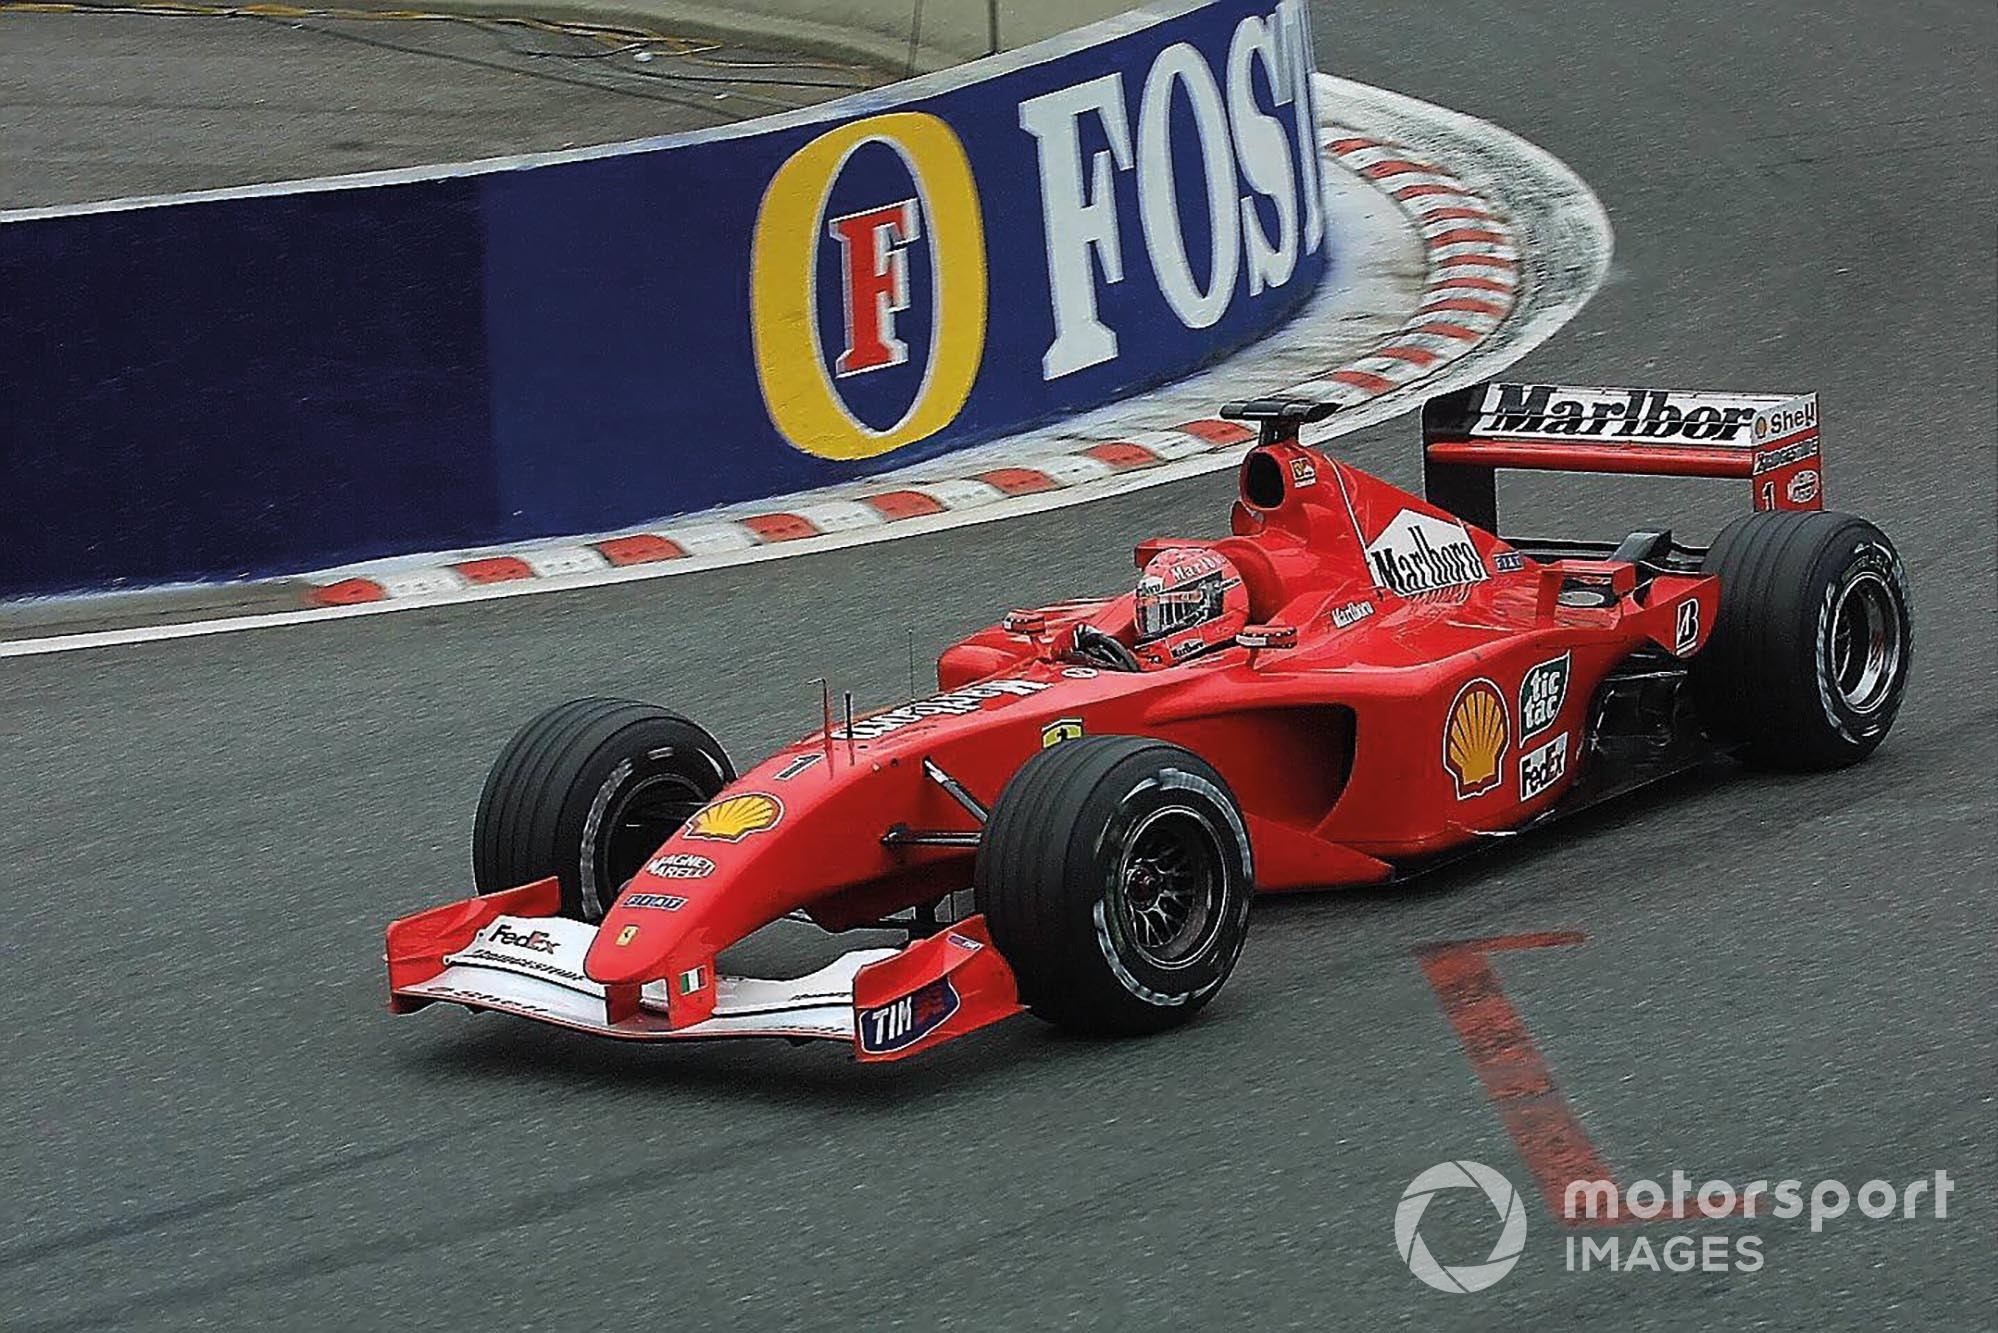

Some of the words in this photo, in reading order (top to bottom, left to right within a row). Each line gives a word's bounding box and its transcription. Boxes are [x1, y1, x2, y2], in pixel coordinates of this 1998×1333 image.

[1770, 402, 1815, 435] Shell
[1371, 525, 1482, 594] Marlboro
[1530, 669, 1560, 702] tic
[1523, 695, 1558, 729] tac
[489, 924, 561, 954] FedEx
[872, 996, 912, 1045] TIM
